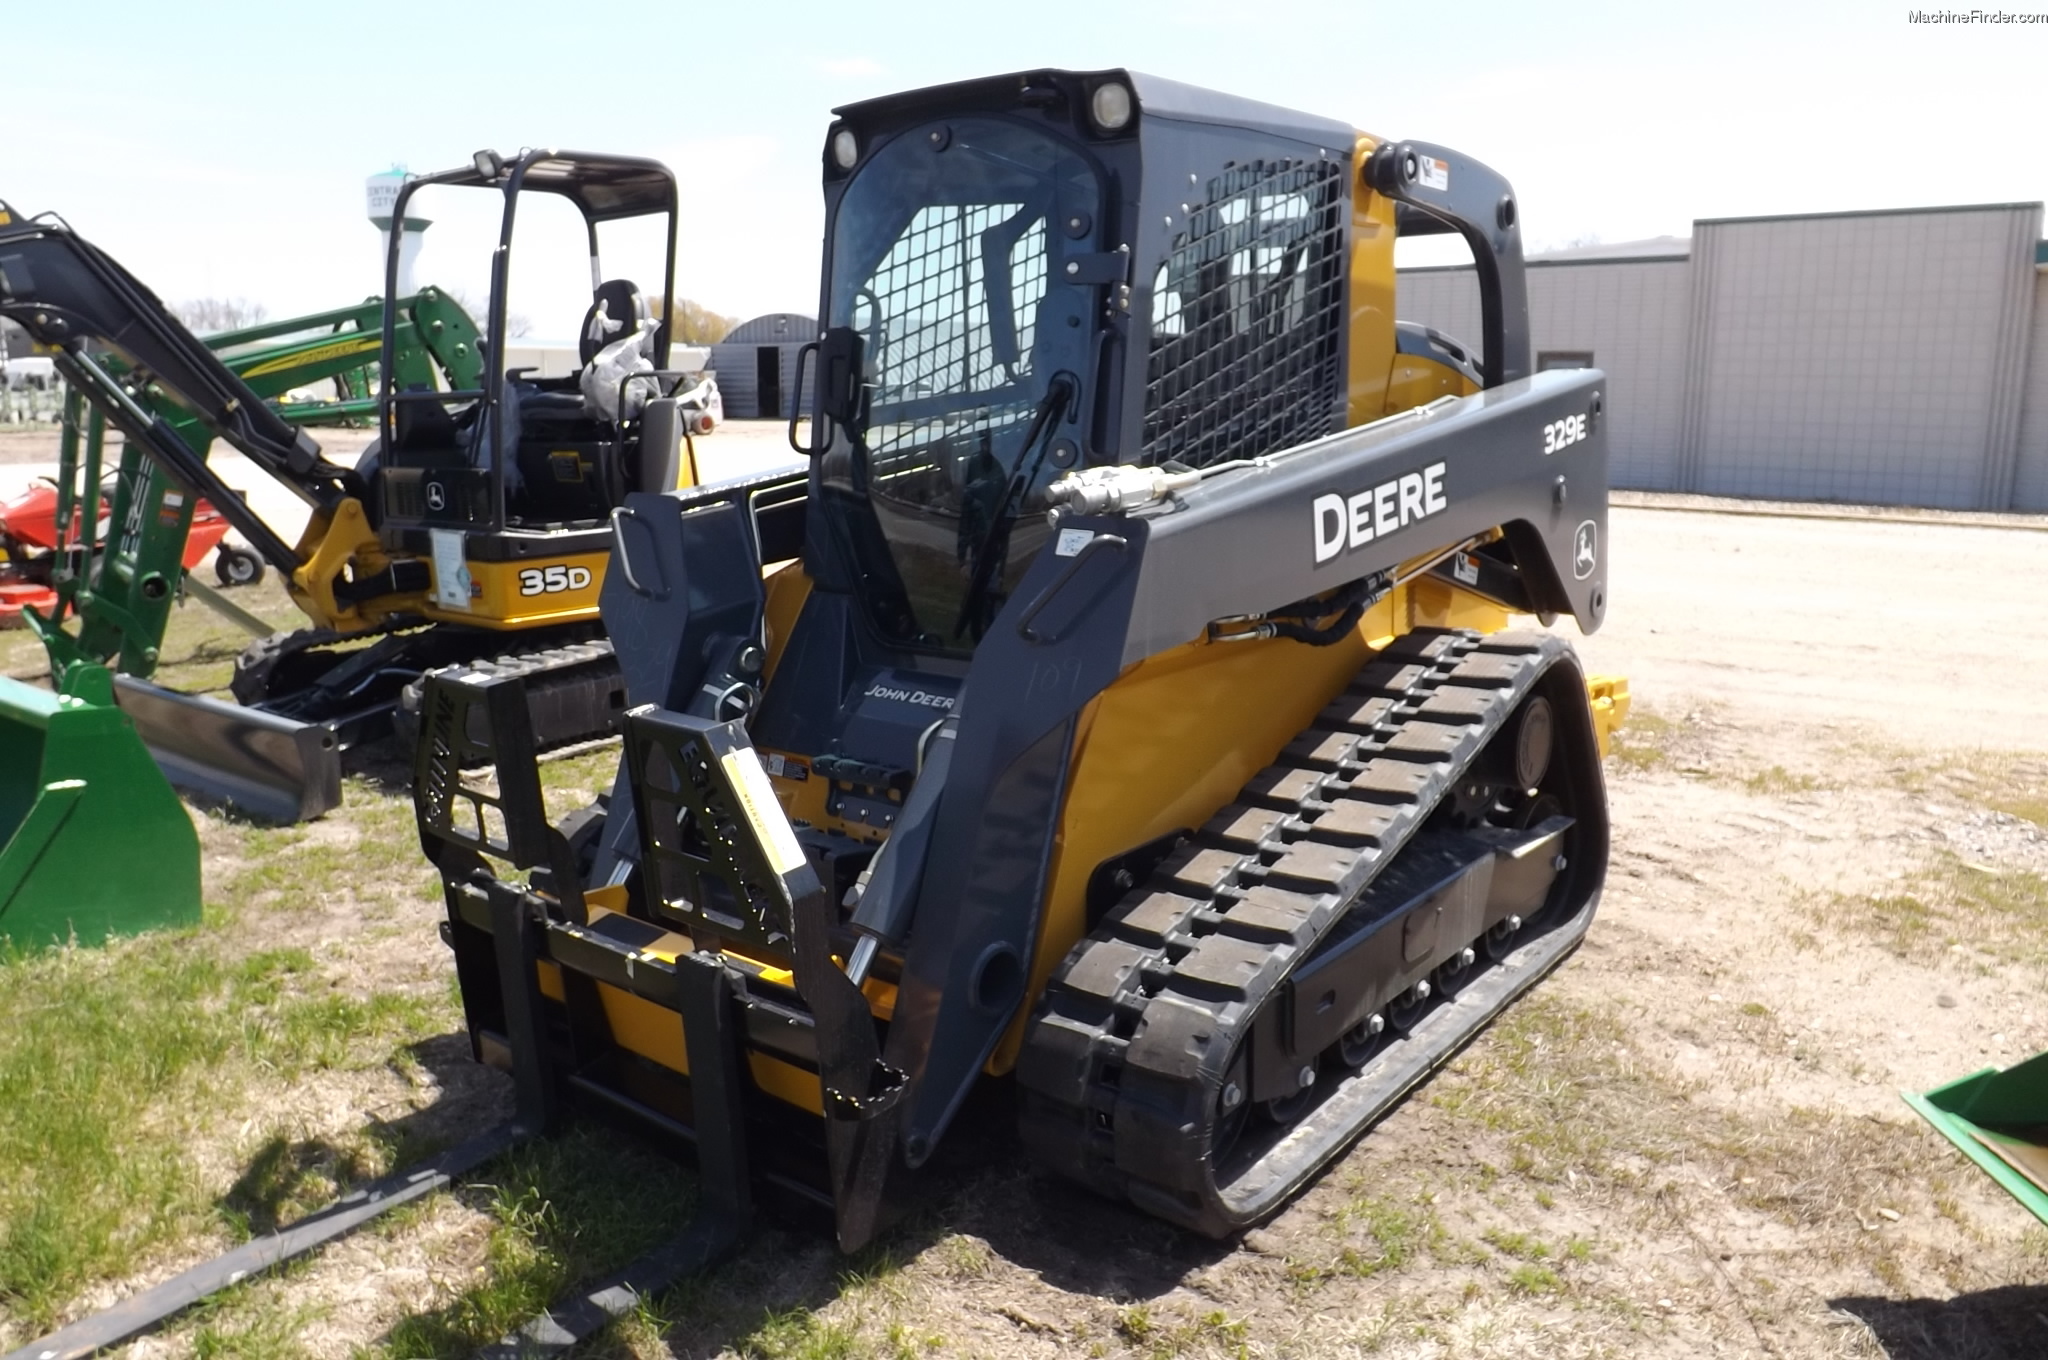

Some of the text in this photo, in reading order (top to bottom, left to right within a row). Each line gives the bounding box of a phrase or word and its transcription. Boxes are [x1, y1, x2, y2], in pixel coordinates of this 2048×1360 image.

[1544, 413, 1587, 455] 329E
[1313, 461, 1447, 563] DEERE
[519, 565, 592, 596] 35D
[864, 684, 955, 709] JOHN DEER
